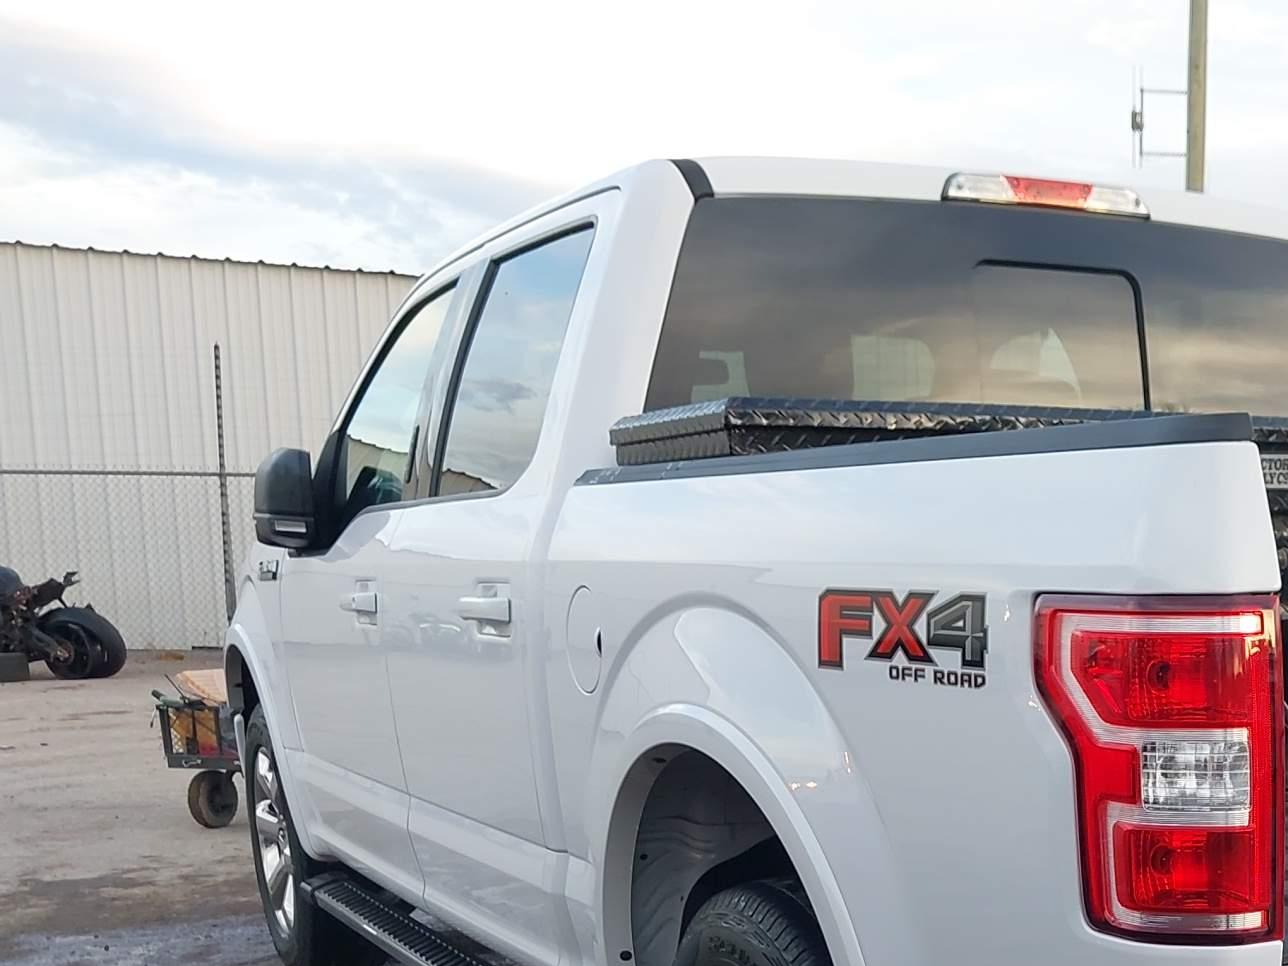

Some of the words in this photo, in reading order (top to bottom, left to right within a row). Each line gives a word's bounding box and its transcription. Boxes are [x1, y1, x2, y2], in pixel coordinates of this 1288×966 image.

[818, 588, 988, 670] FX4
[889, 665, 926, 682] OFF
[933, 669, 986, 689] ROAD
